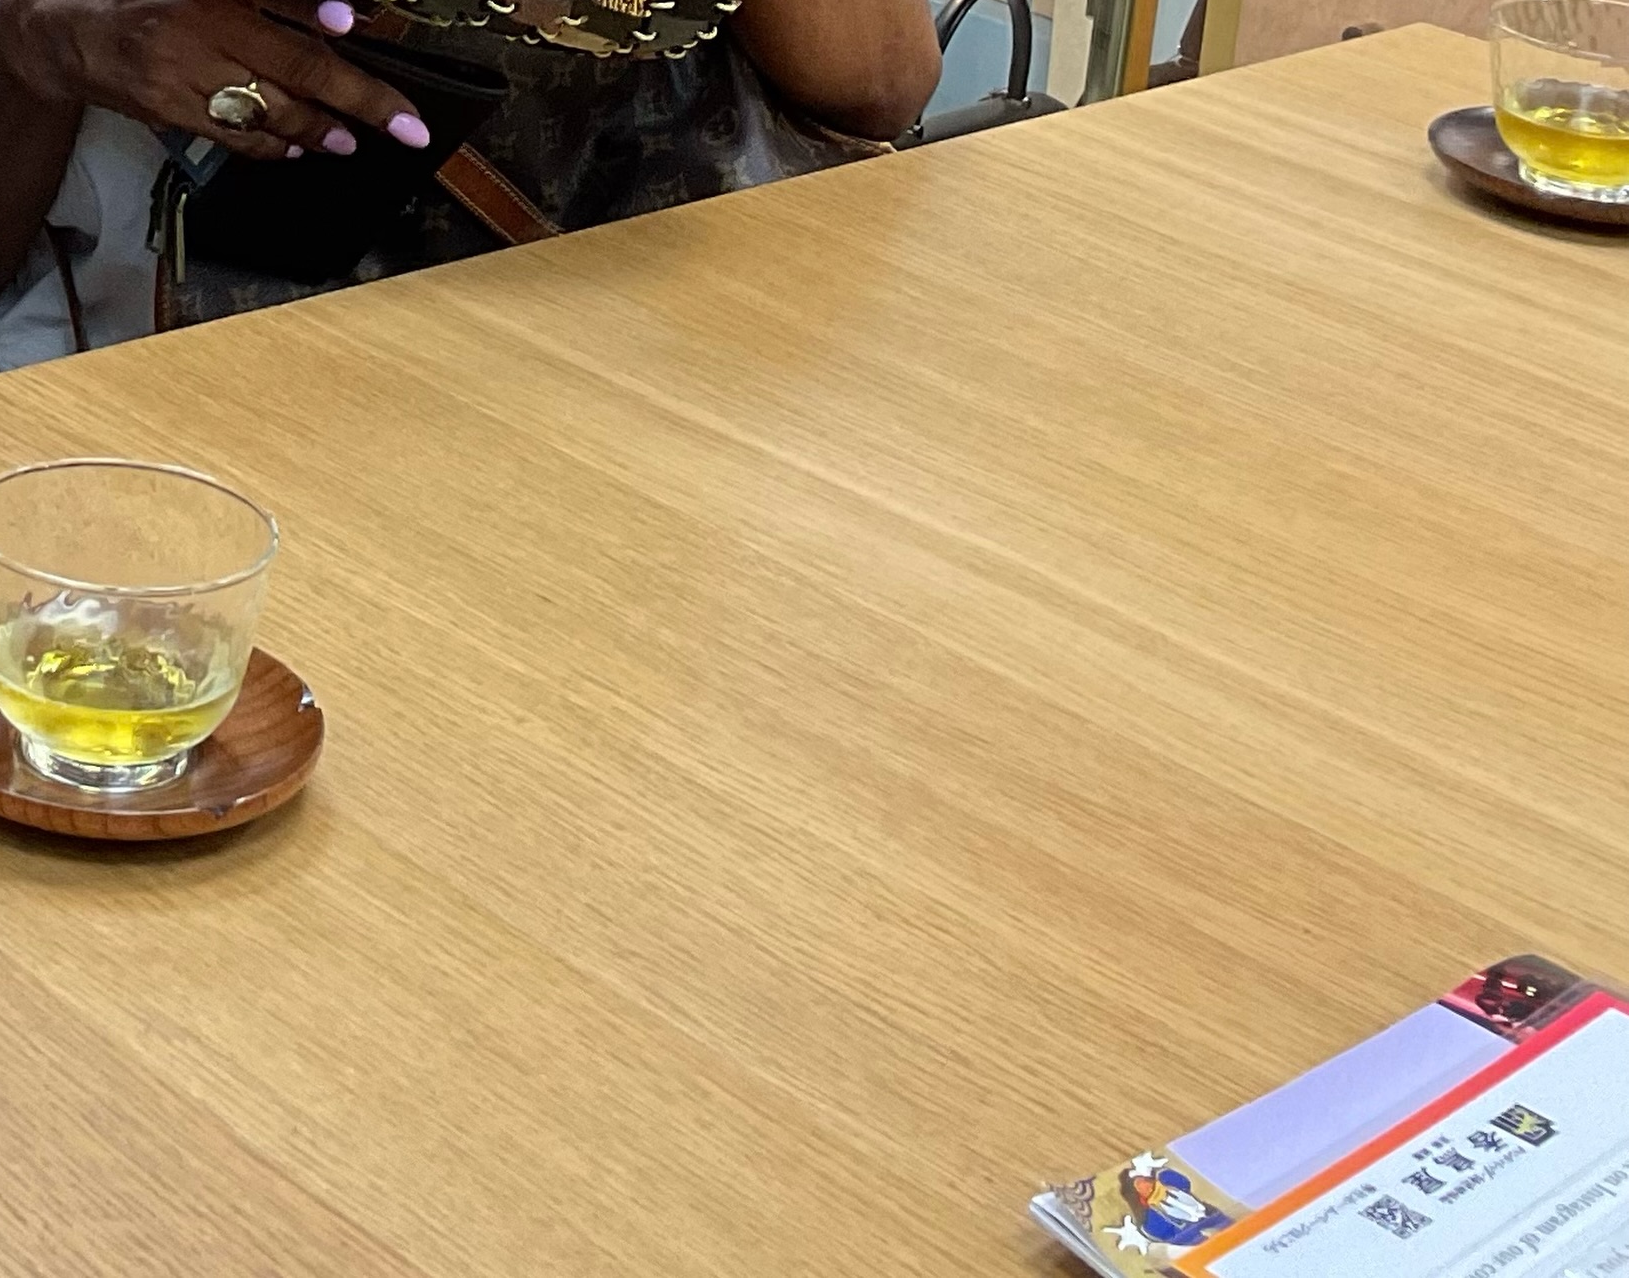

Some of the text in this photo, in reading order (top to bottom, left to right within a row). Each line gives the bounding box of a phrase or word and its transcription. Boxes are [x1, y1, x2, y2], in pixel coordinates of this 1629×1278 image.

[1603, 1170, 1628, 1186] on
[1534, 1182, 1618, 1235] Instagram
[1519, 1233, 1541, 1255] of
